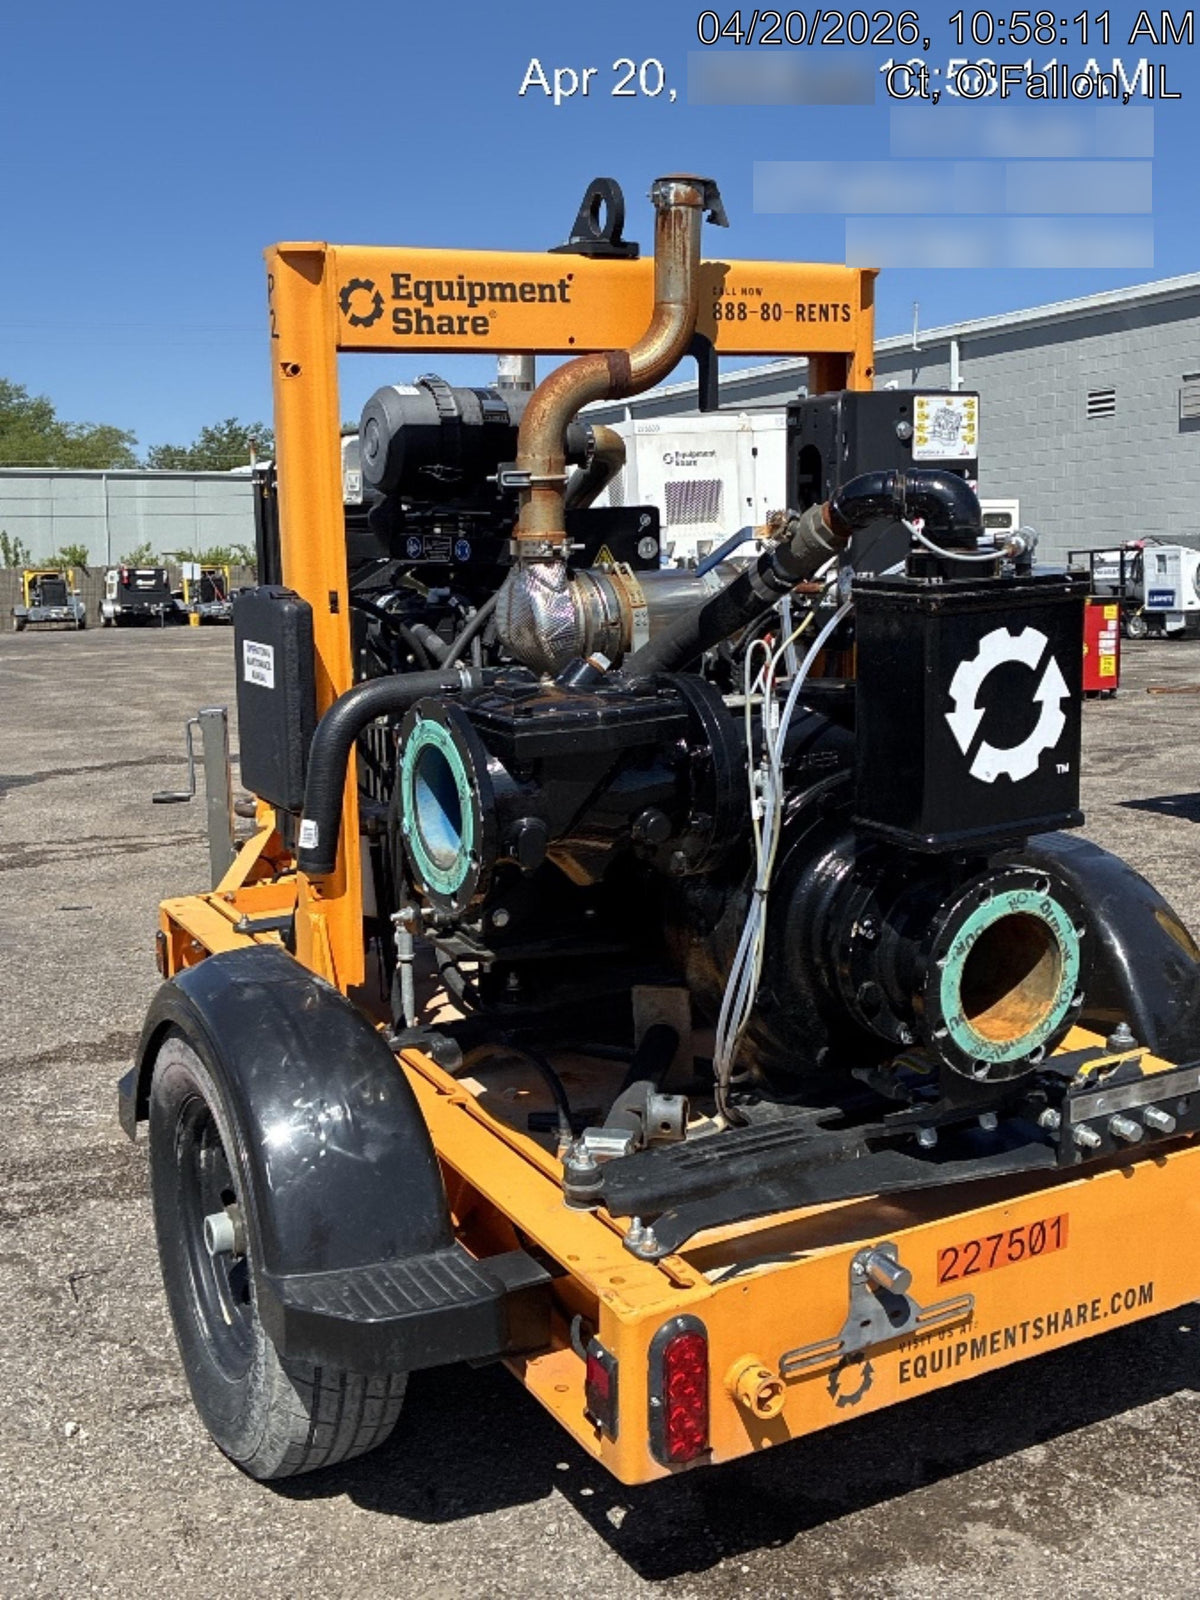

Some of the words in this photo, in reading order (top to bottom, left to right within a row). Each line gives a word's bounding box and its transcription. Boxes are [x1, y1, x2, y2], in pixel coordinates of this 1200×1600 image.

[391, 272, 572, 308] Equipment
[740, 287, 764, 297] NOW
[711, 301, 852, 323] 888-80-RENTS
[939, 1217, 1063, 1285] 227501
[898, 1281, 1155, 1385] EQUIPMENTSHARE.COM
[937, 1327, 954, 1341] US
